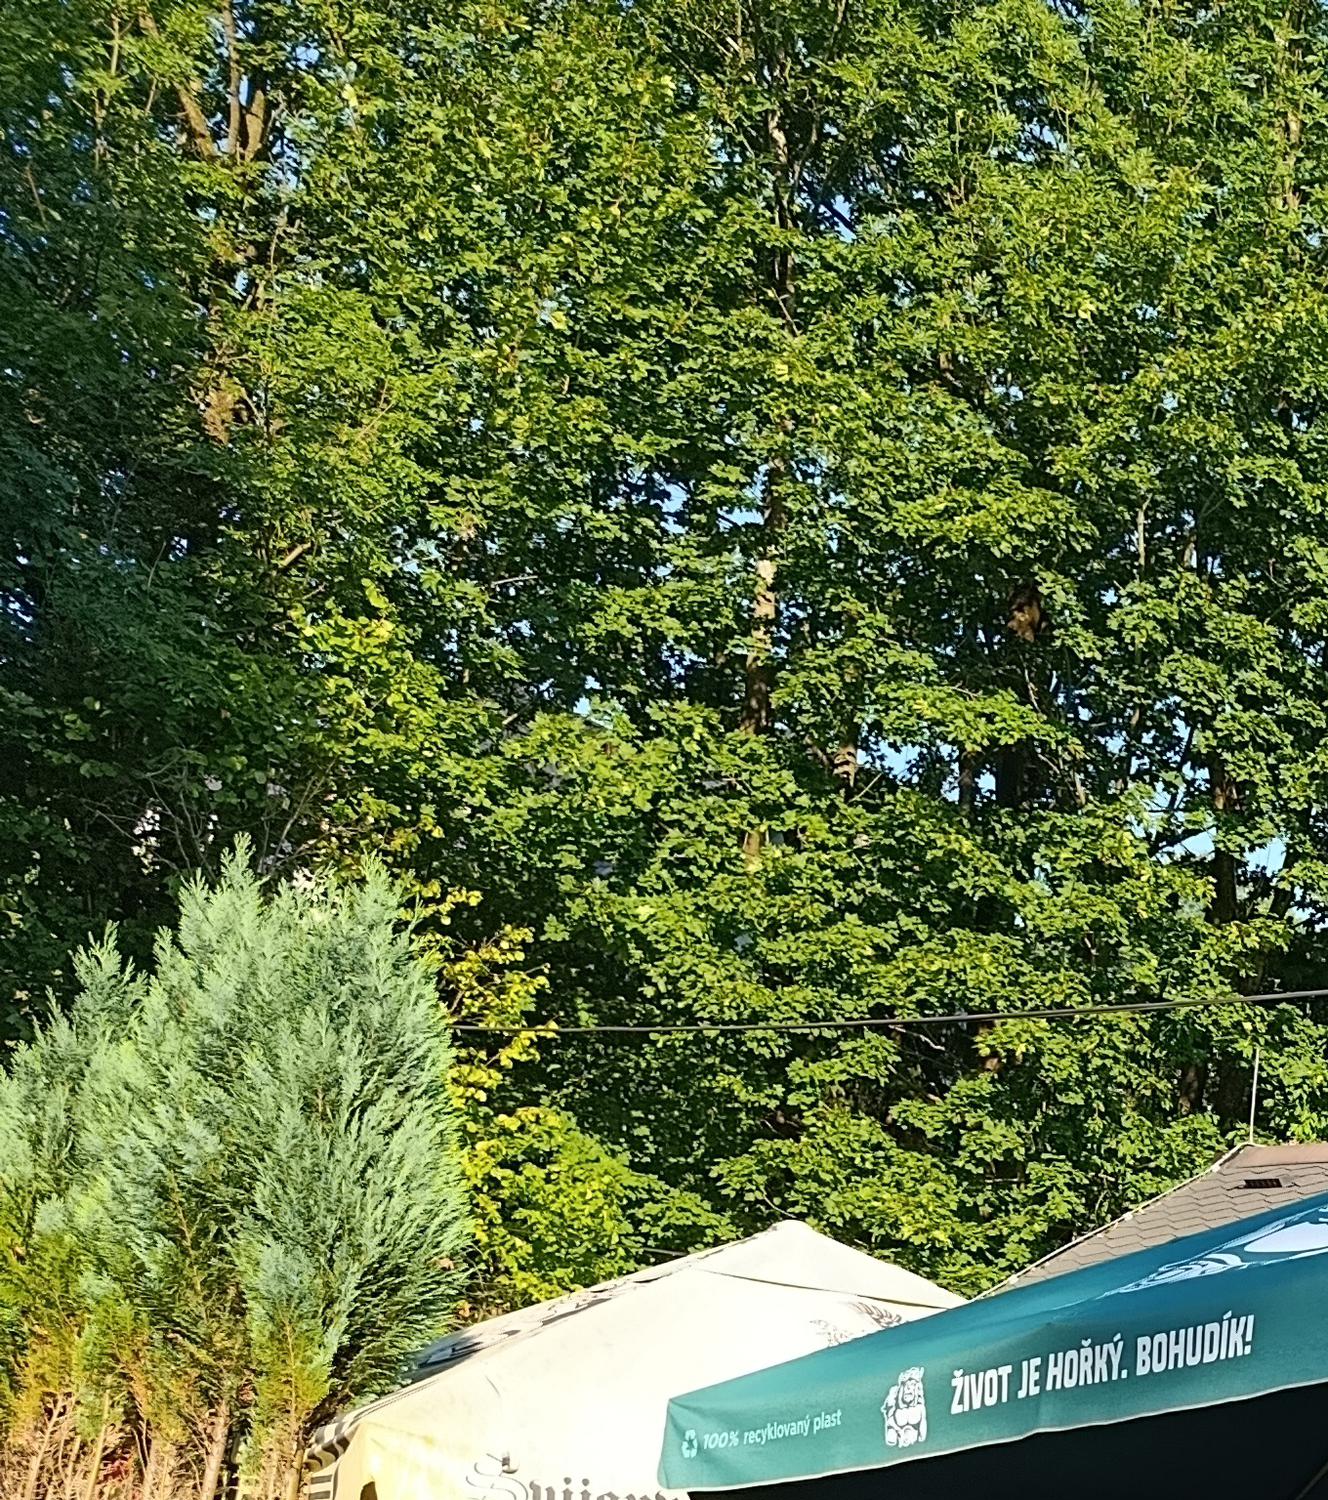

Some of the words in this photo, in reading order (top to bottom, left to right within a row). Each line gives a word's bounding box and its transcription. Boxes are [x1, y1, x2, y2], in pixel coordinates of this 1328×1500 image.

[950, 1364, 1011, 1415] ŽIVOT
[1017, 1357, 1041, 1399] JE
[1046, 1332, 1128, 1392] HOŘKÝ.
[1136, 1310, 1254, 1376] BOHUDÍK!
[703, 1430, 740, 1451] 100%
[743, 1416, 811, 1446] recyklovaný
[813, 1409, 843, 1440] plast
